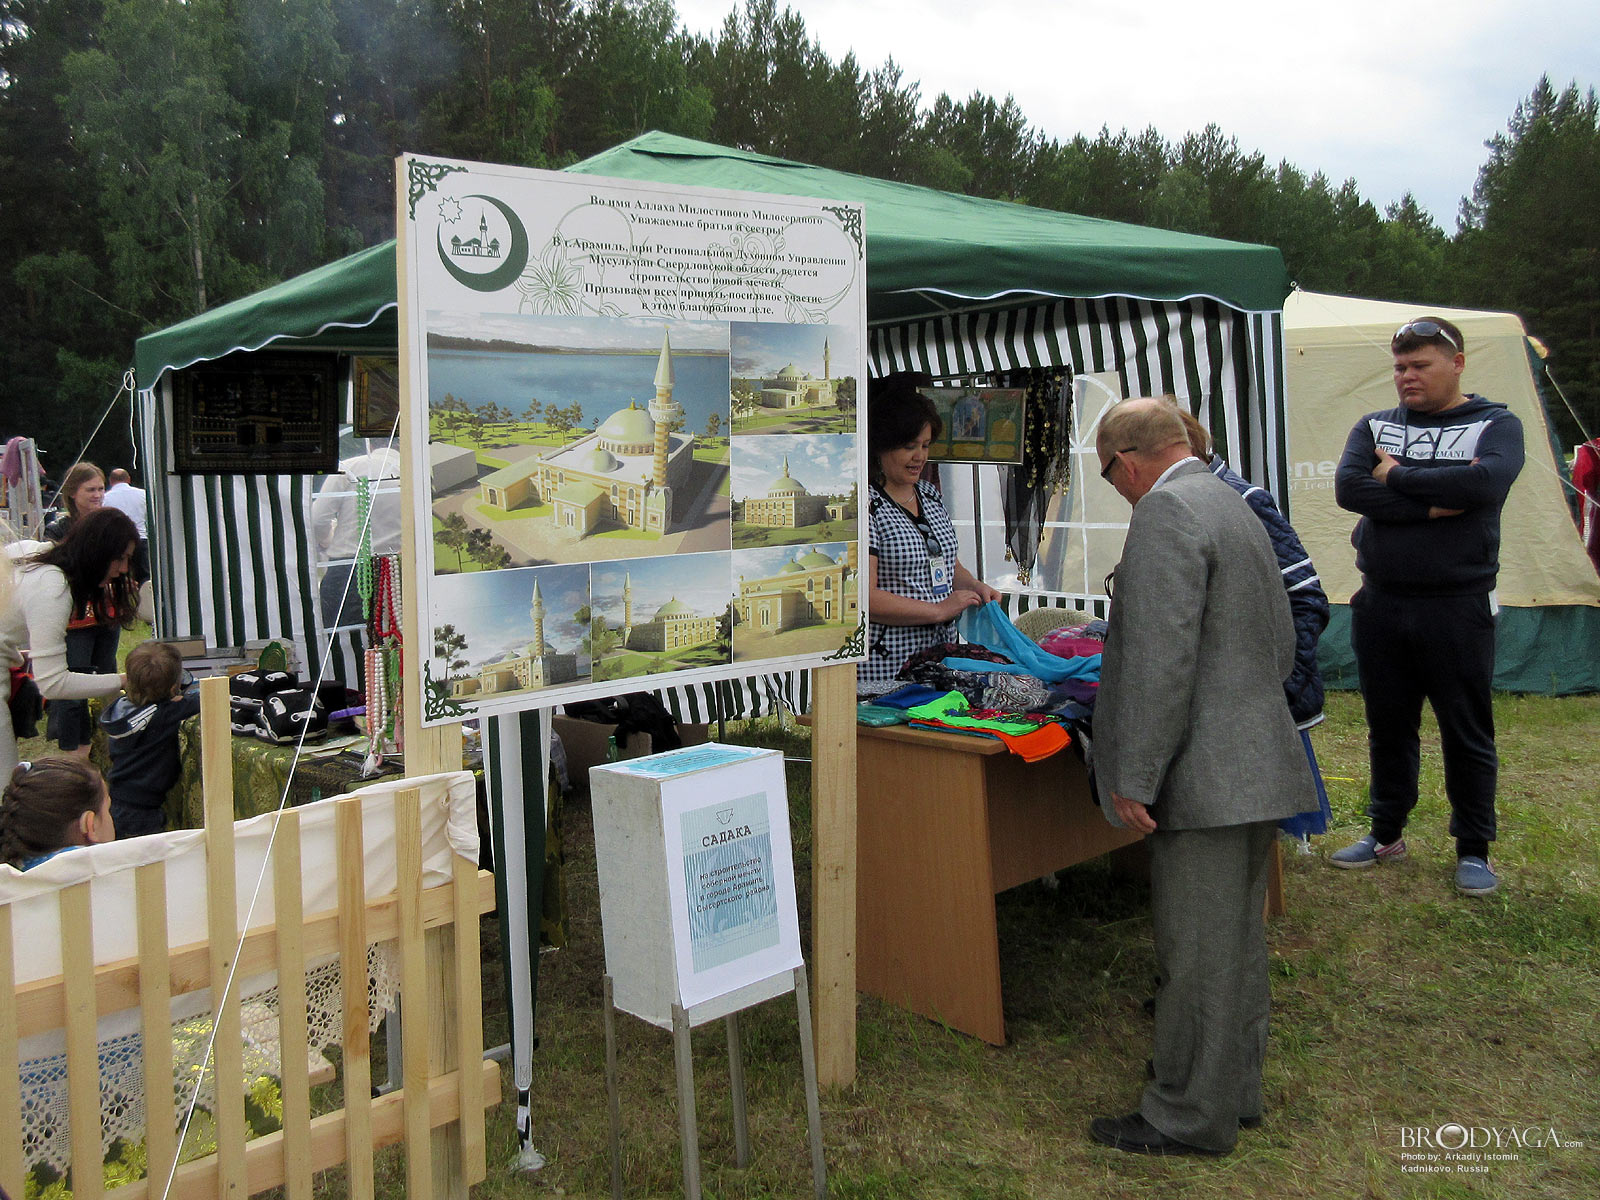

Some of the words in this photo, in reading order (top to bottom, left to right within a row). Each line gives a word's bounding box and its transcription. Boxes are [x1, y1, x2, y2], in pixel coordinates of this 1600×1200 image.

[590, 195, 605, 206] Во
[608, 199, 631, 208] имя
[634, 199, 675, 213] Аллаха
[678, 203, 749, 218] Милостивого
[752, 210, 823, 225] Милосердного
[630, 213, 694, 228] Уважаемые
[697, 219, 733, 232] братья
[736, 224, 743, 232] и
[745, 226, 784, 236] сестры!
[553, 237, 561, 247] В
[632, 245, 652, 255] при
[656, 244, 733, 258] Региональном
[736, 249, 785, 262] Духовном
[788, 253, 846, 266] Управлении
[589, 254, 654, 267] Мусульман
[657, 258, 733, 272] Свердловской
[736, 264, 779, 275] области,
[781, 269, 818, 278] ведется
[629, 273, 709, 284] строительство
[712, 276, 742, 287] новой
[585, 283, 650, 295] Призываем
[654, 289, 677, 297] всех
[681, 289, 726, 300] принять
[730, 292, 782, 302] посильное
[784, 295, 822, 305] участие
[642, 302, 648, 310] в
[651, 302, 676, 311] этом
[680, 302, 746, 314] благородном
[749, 306, 774, 315] деле.
[1376, 424, 1469, 451] EA7
[702, 825, 752, 847] САДАКА
[711, 857, 761, 877] строительство
[696, 893, 743, 913] Сысертского
[745, 884, 770, 899] района
[706, 886, 731, 900] городе
[733, 878, 763, 890] Арамиль
